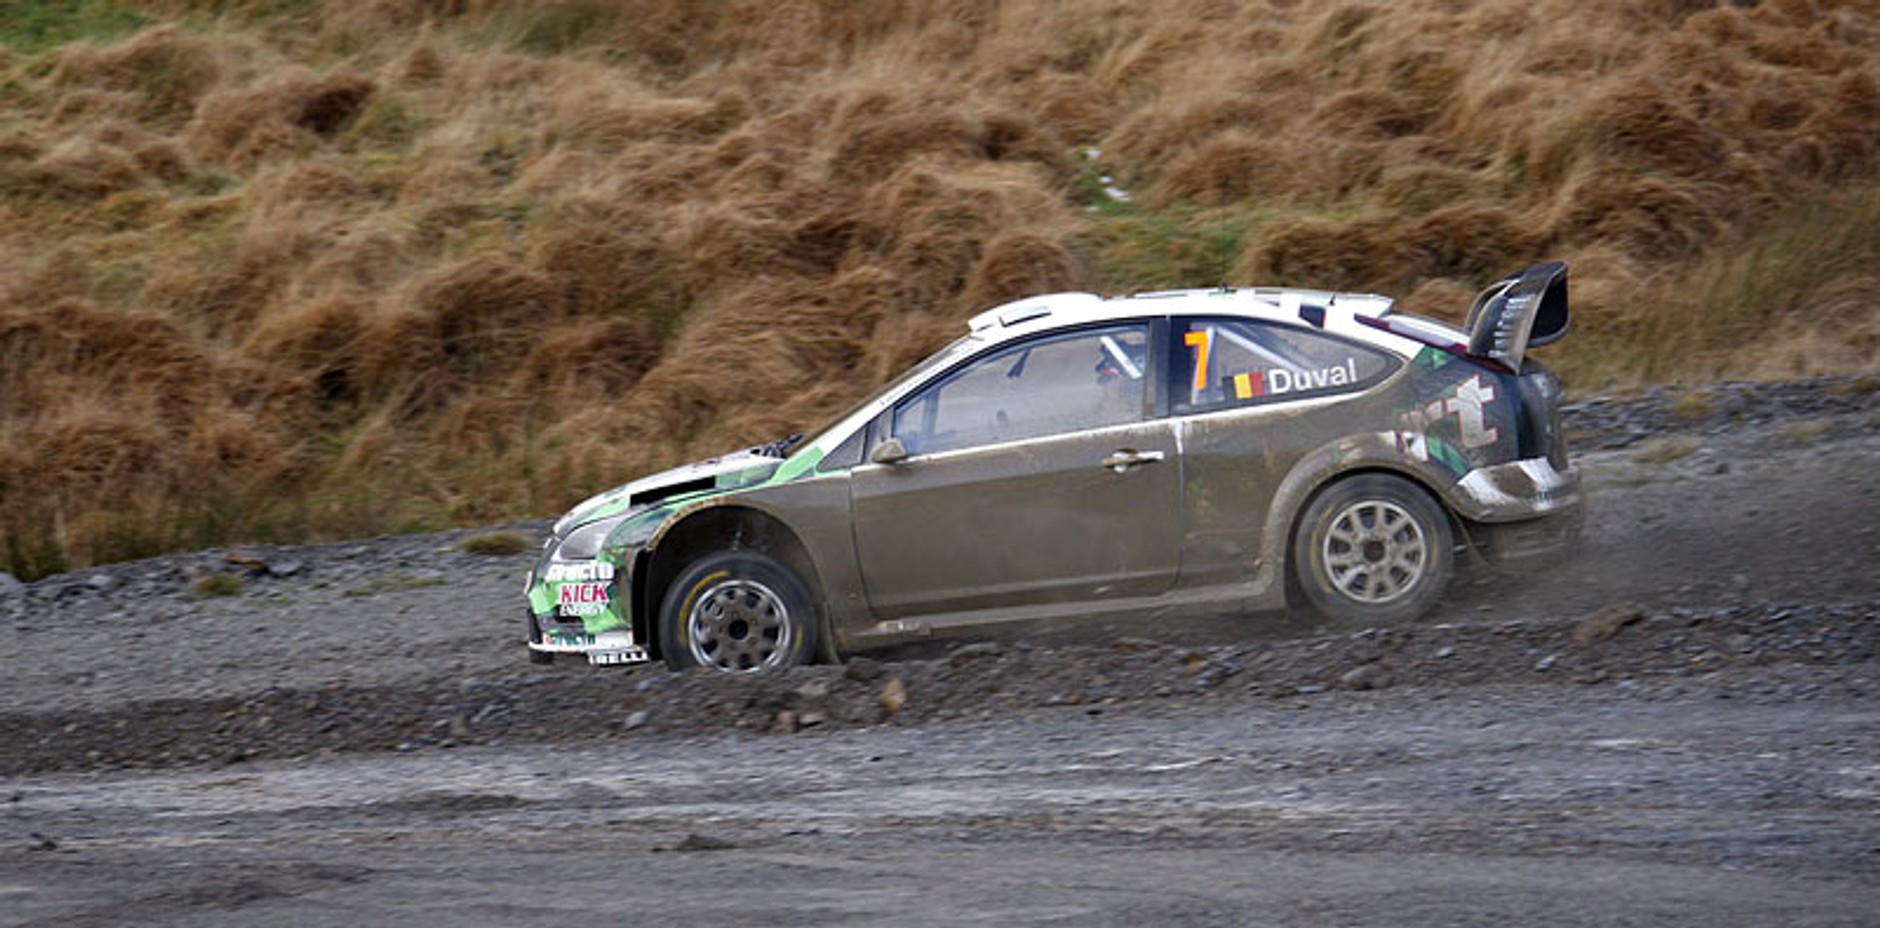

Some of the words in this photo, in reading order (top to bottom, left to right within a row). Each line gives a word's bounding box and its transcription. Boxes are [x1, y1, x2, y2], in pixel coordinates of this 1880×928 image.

[1184, 330, 1209, 390] 7
[1268, 357, 1358, 394] Duval
[561, 583, 609, 604] KICK
